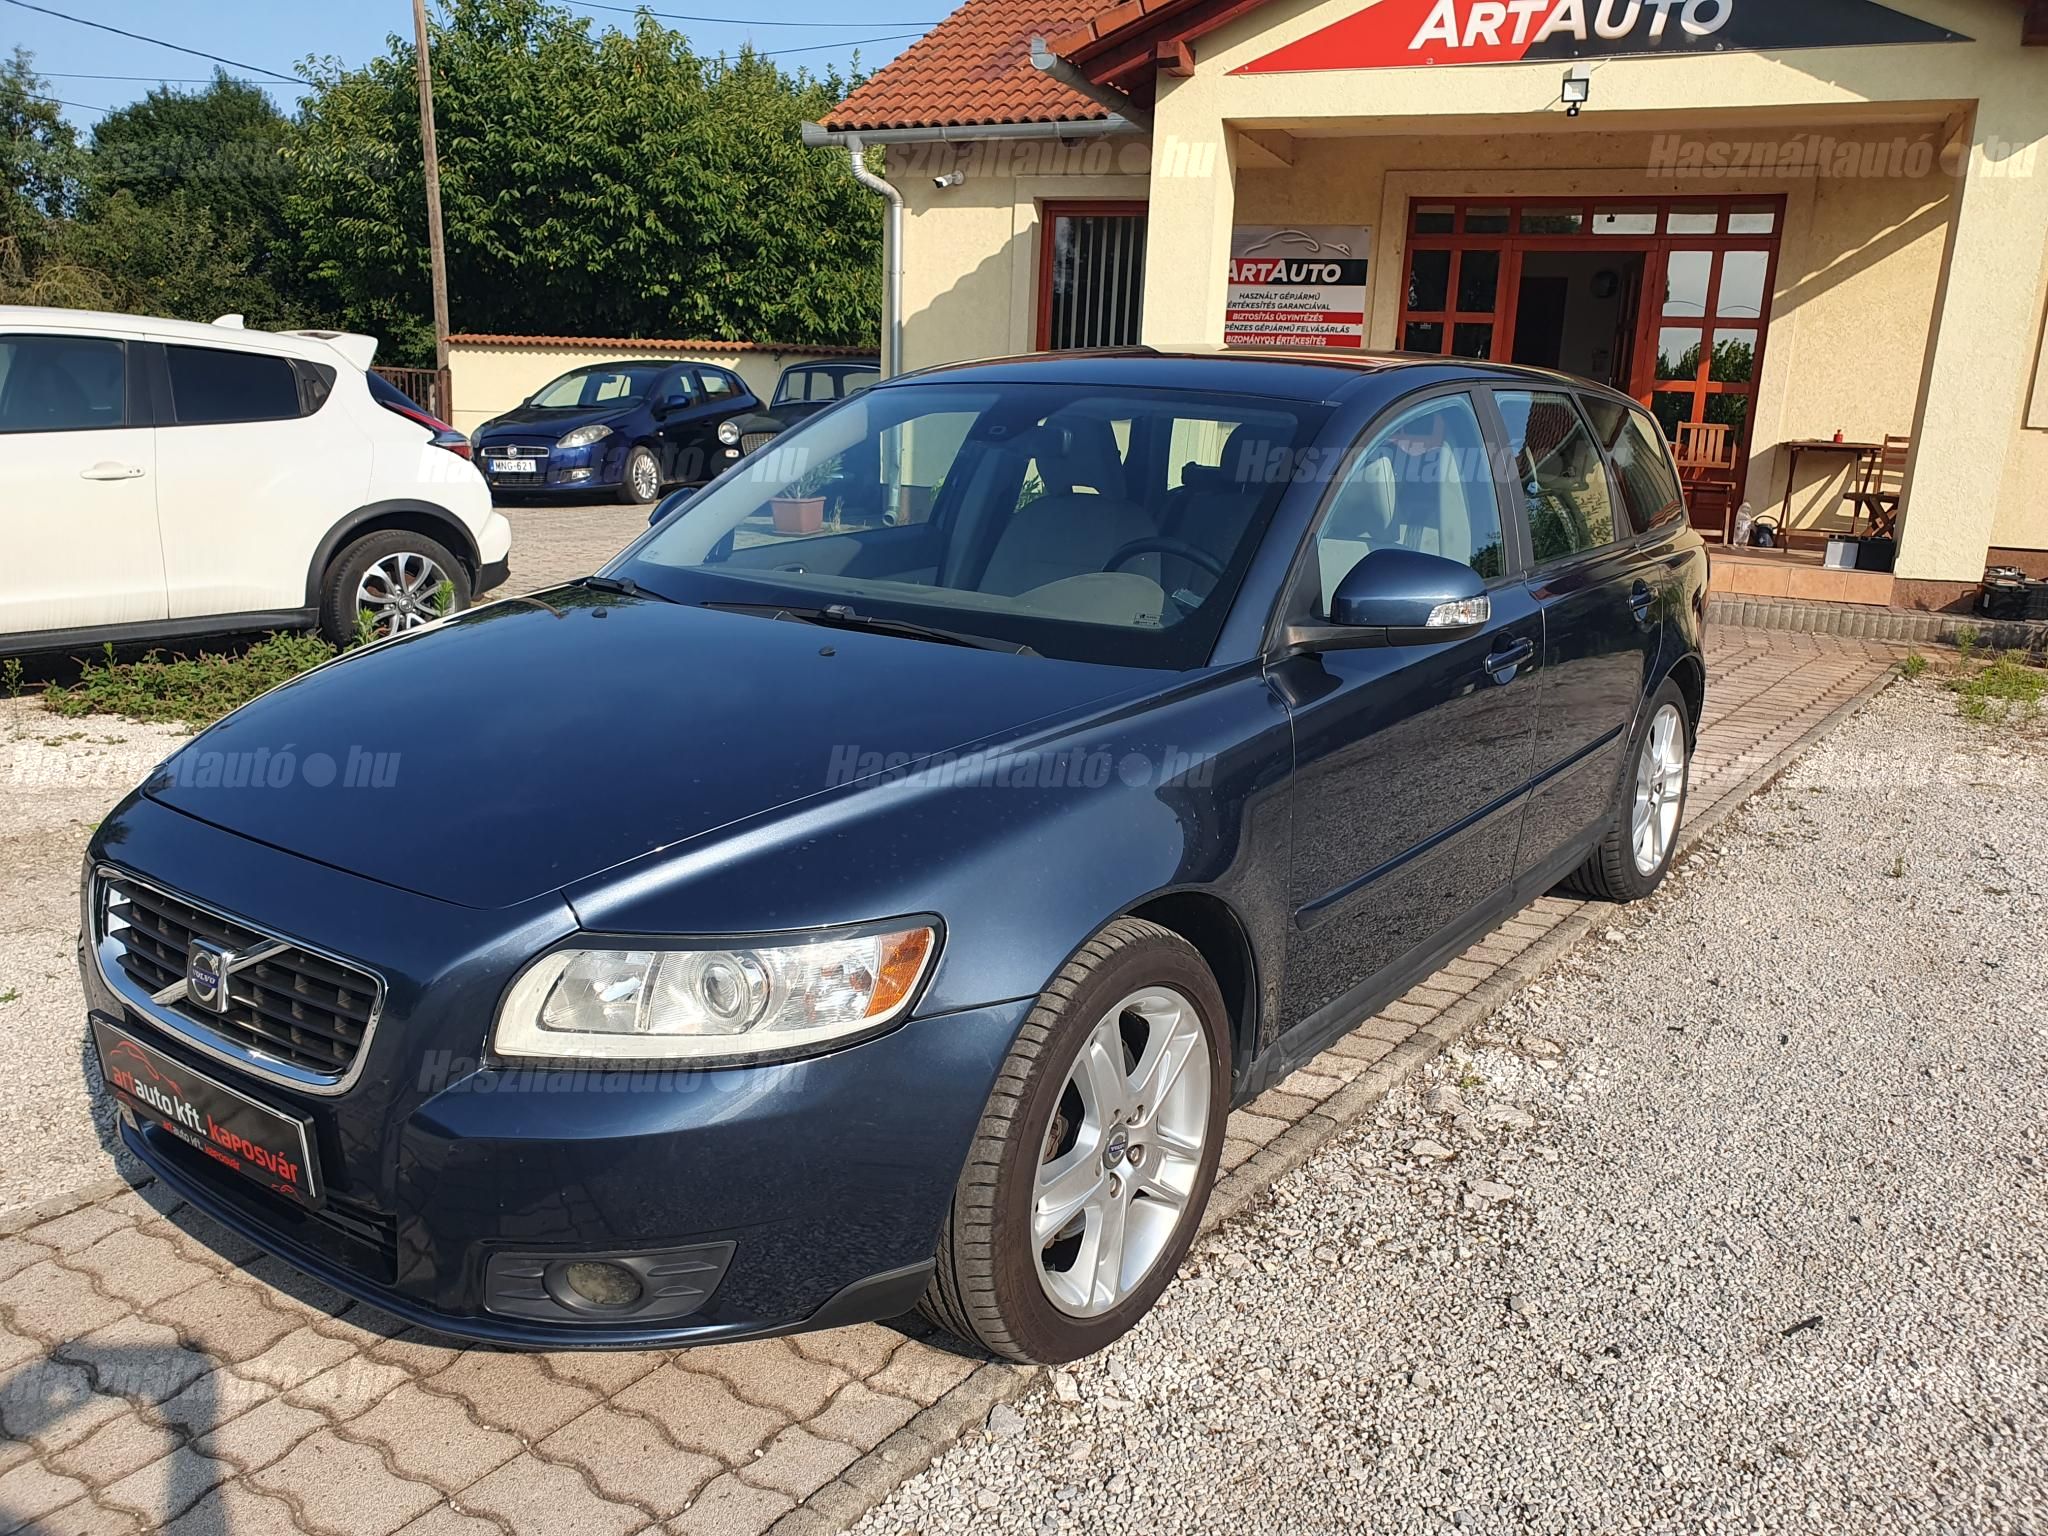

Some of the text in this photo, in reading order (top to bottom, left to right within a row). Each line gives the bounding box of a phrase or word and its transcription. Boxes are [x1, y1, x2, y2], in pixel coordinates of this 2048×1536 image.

[1239, 292, 1278, 301] HASZNÁLT
[1227, 300, 1331, 311] ÉRTÉKESÍTÉS GARANCIÁVAL
[1232, 312, 1324, 322] BIZTOSÍTÁS ÜGYINTÉZÉS
[1296, 324, 1350, 333] FELVÁSÁRLÁS
[1226, 334, 1327, 346] BIZOMÁNYOS ÉRTÉKESÍTÉS
[495, 461, 533, 471] MNG-621
[192, 968, 216, 985] VOLVO
[173, 1095, 208, 1136] kft.
